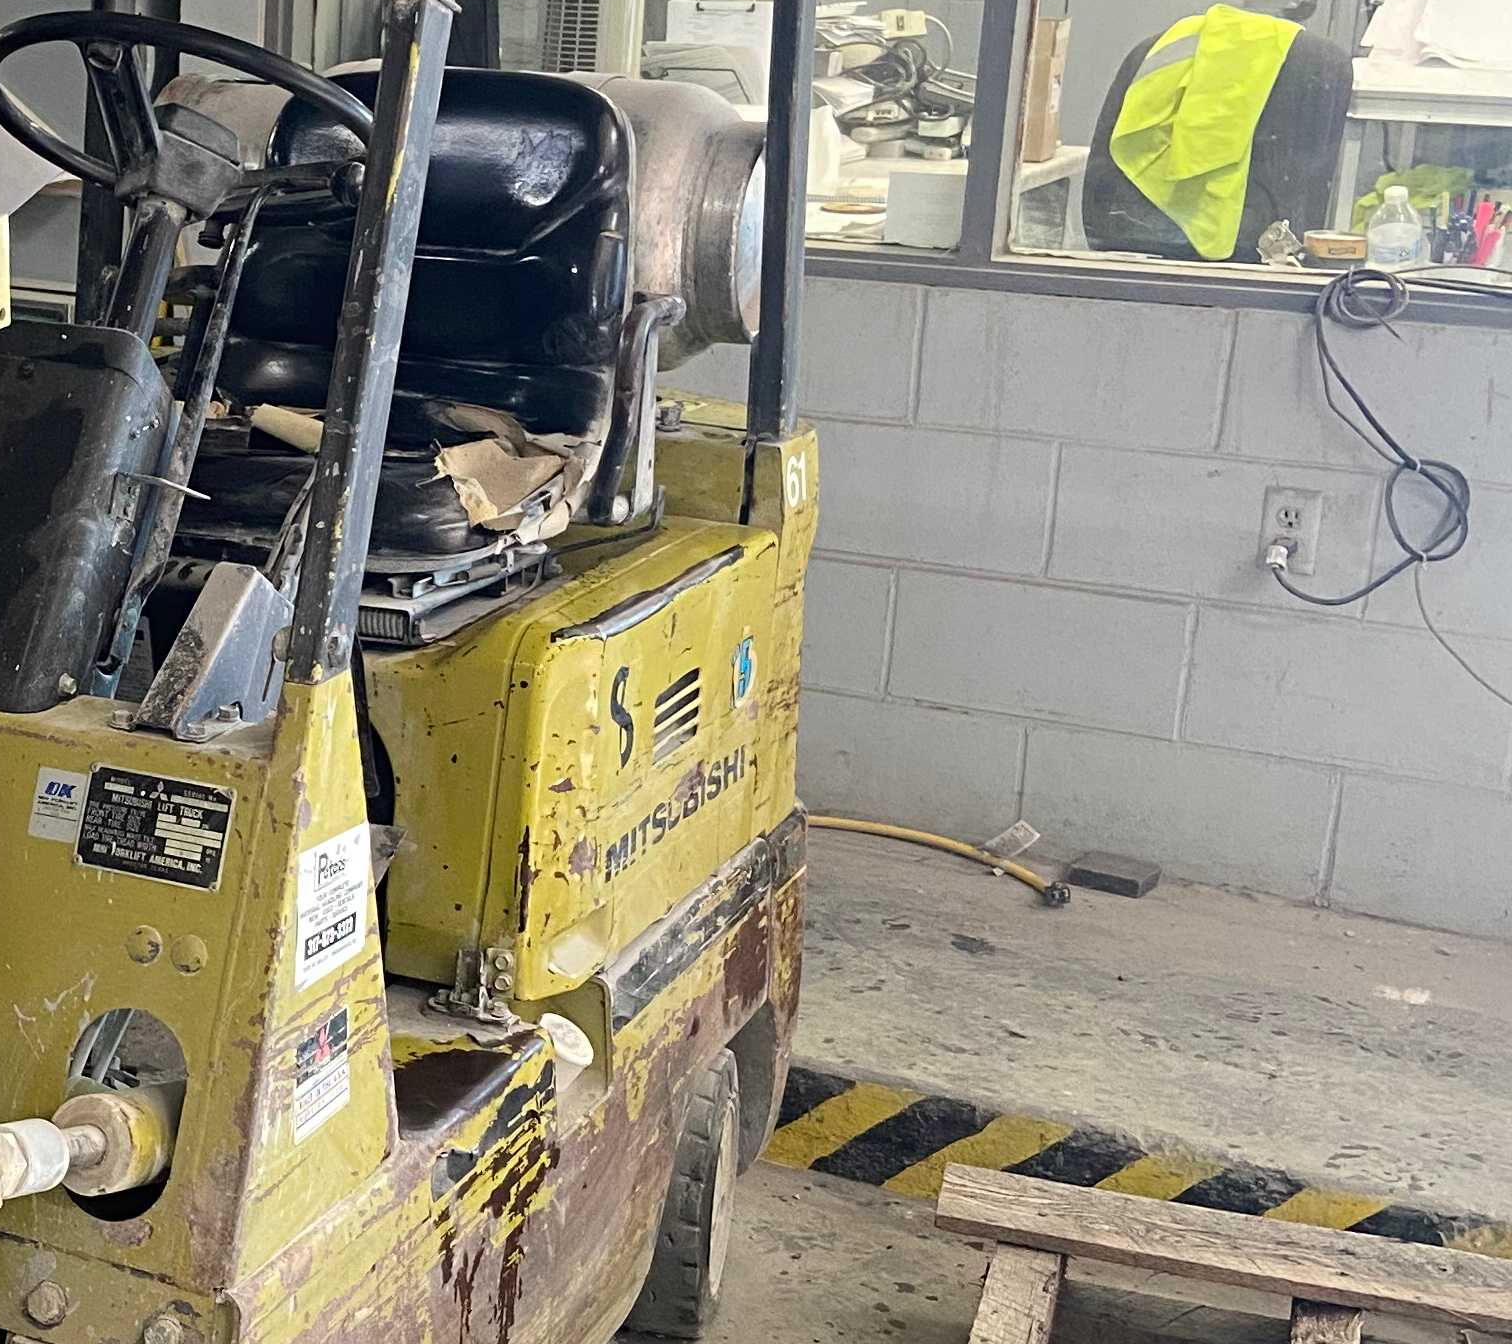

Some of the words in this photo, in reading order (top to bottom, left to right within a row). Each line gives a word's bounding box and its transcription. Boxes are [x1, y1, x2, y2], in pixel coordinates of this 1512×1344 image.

[786, 451, 807, 508] 61
[157, 802, 174, 813] LIFT
[180, 806, 204, 819] TRUCK
